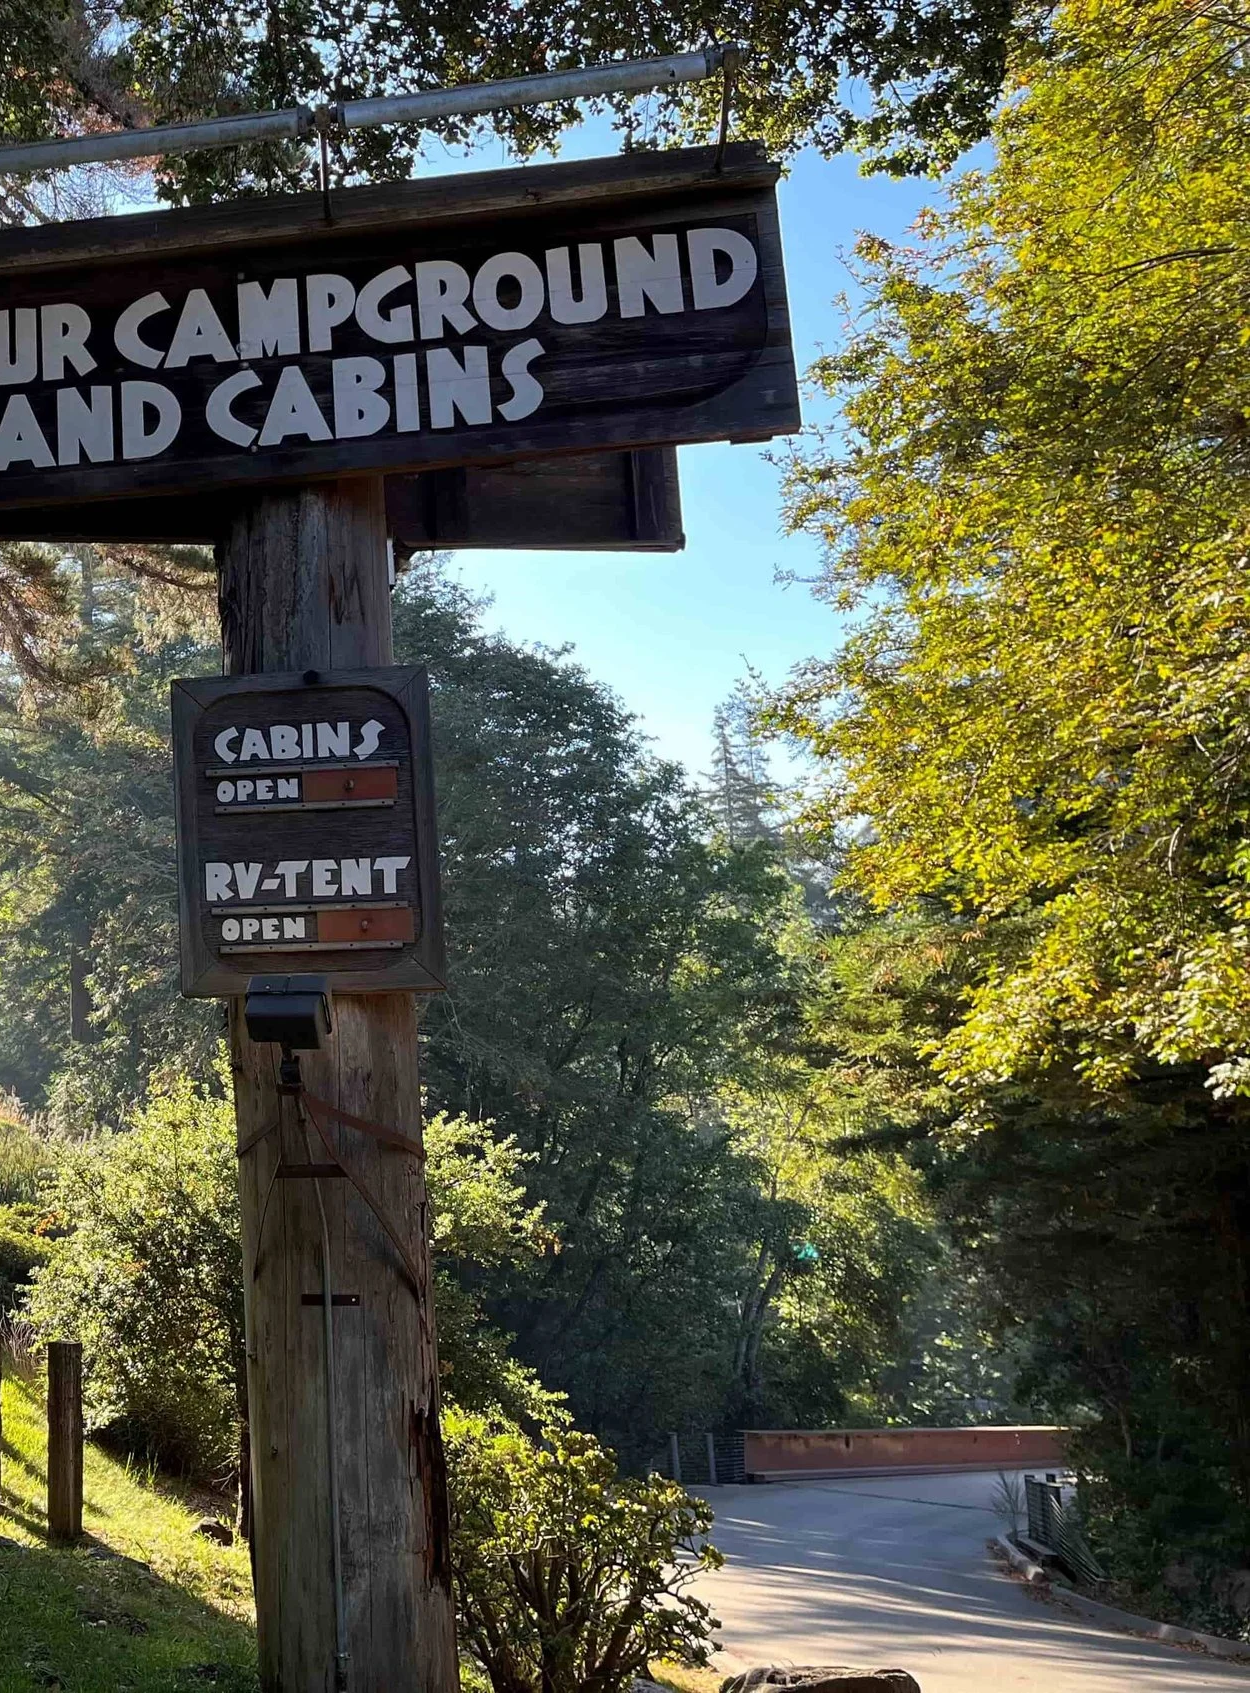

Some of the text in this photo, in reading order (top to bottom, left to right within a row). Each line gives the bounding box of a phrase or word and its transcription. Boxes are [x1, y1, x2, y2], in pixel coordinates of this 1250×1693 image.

[113, 228, 759, 368] CAMPGROUND
[206, 338, 546, 447] CABINS
[214, 719, 386, 764] CABINS
[216, 778, 299, 803] OPEN
[205, 856, 411, 901] RV-TENT
[221, 917, 306, 942] OPEN
